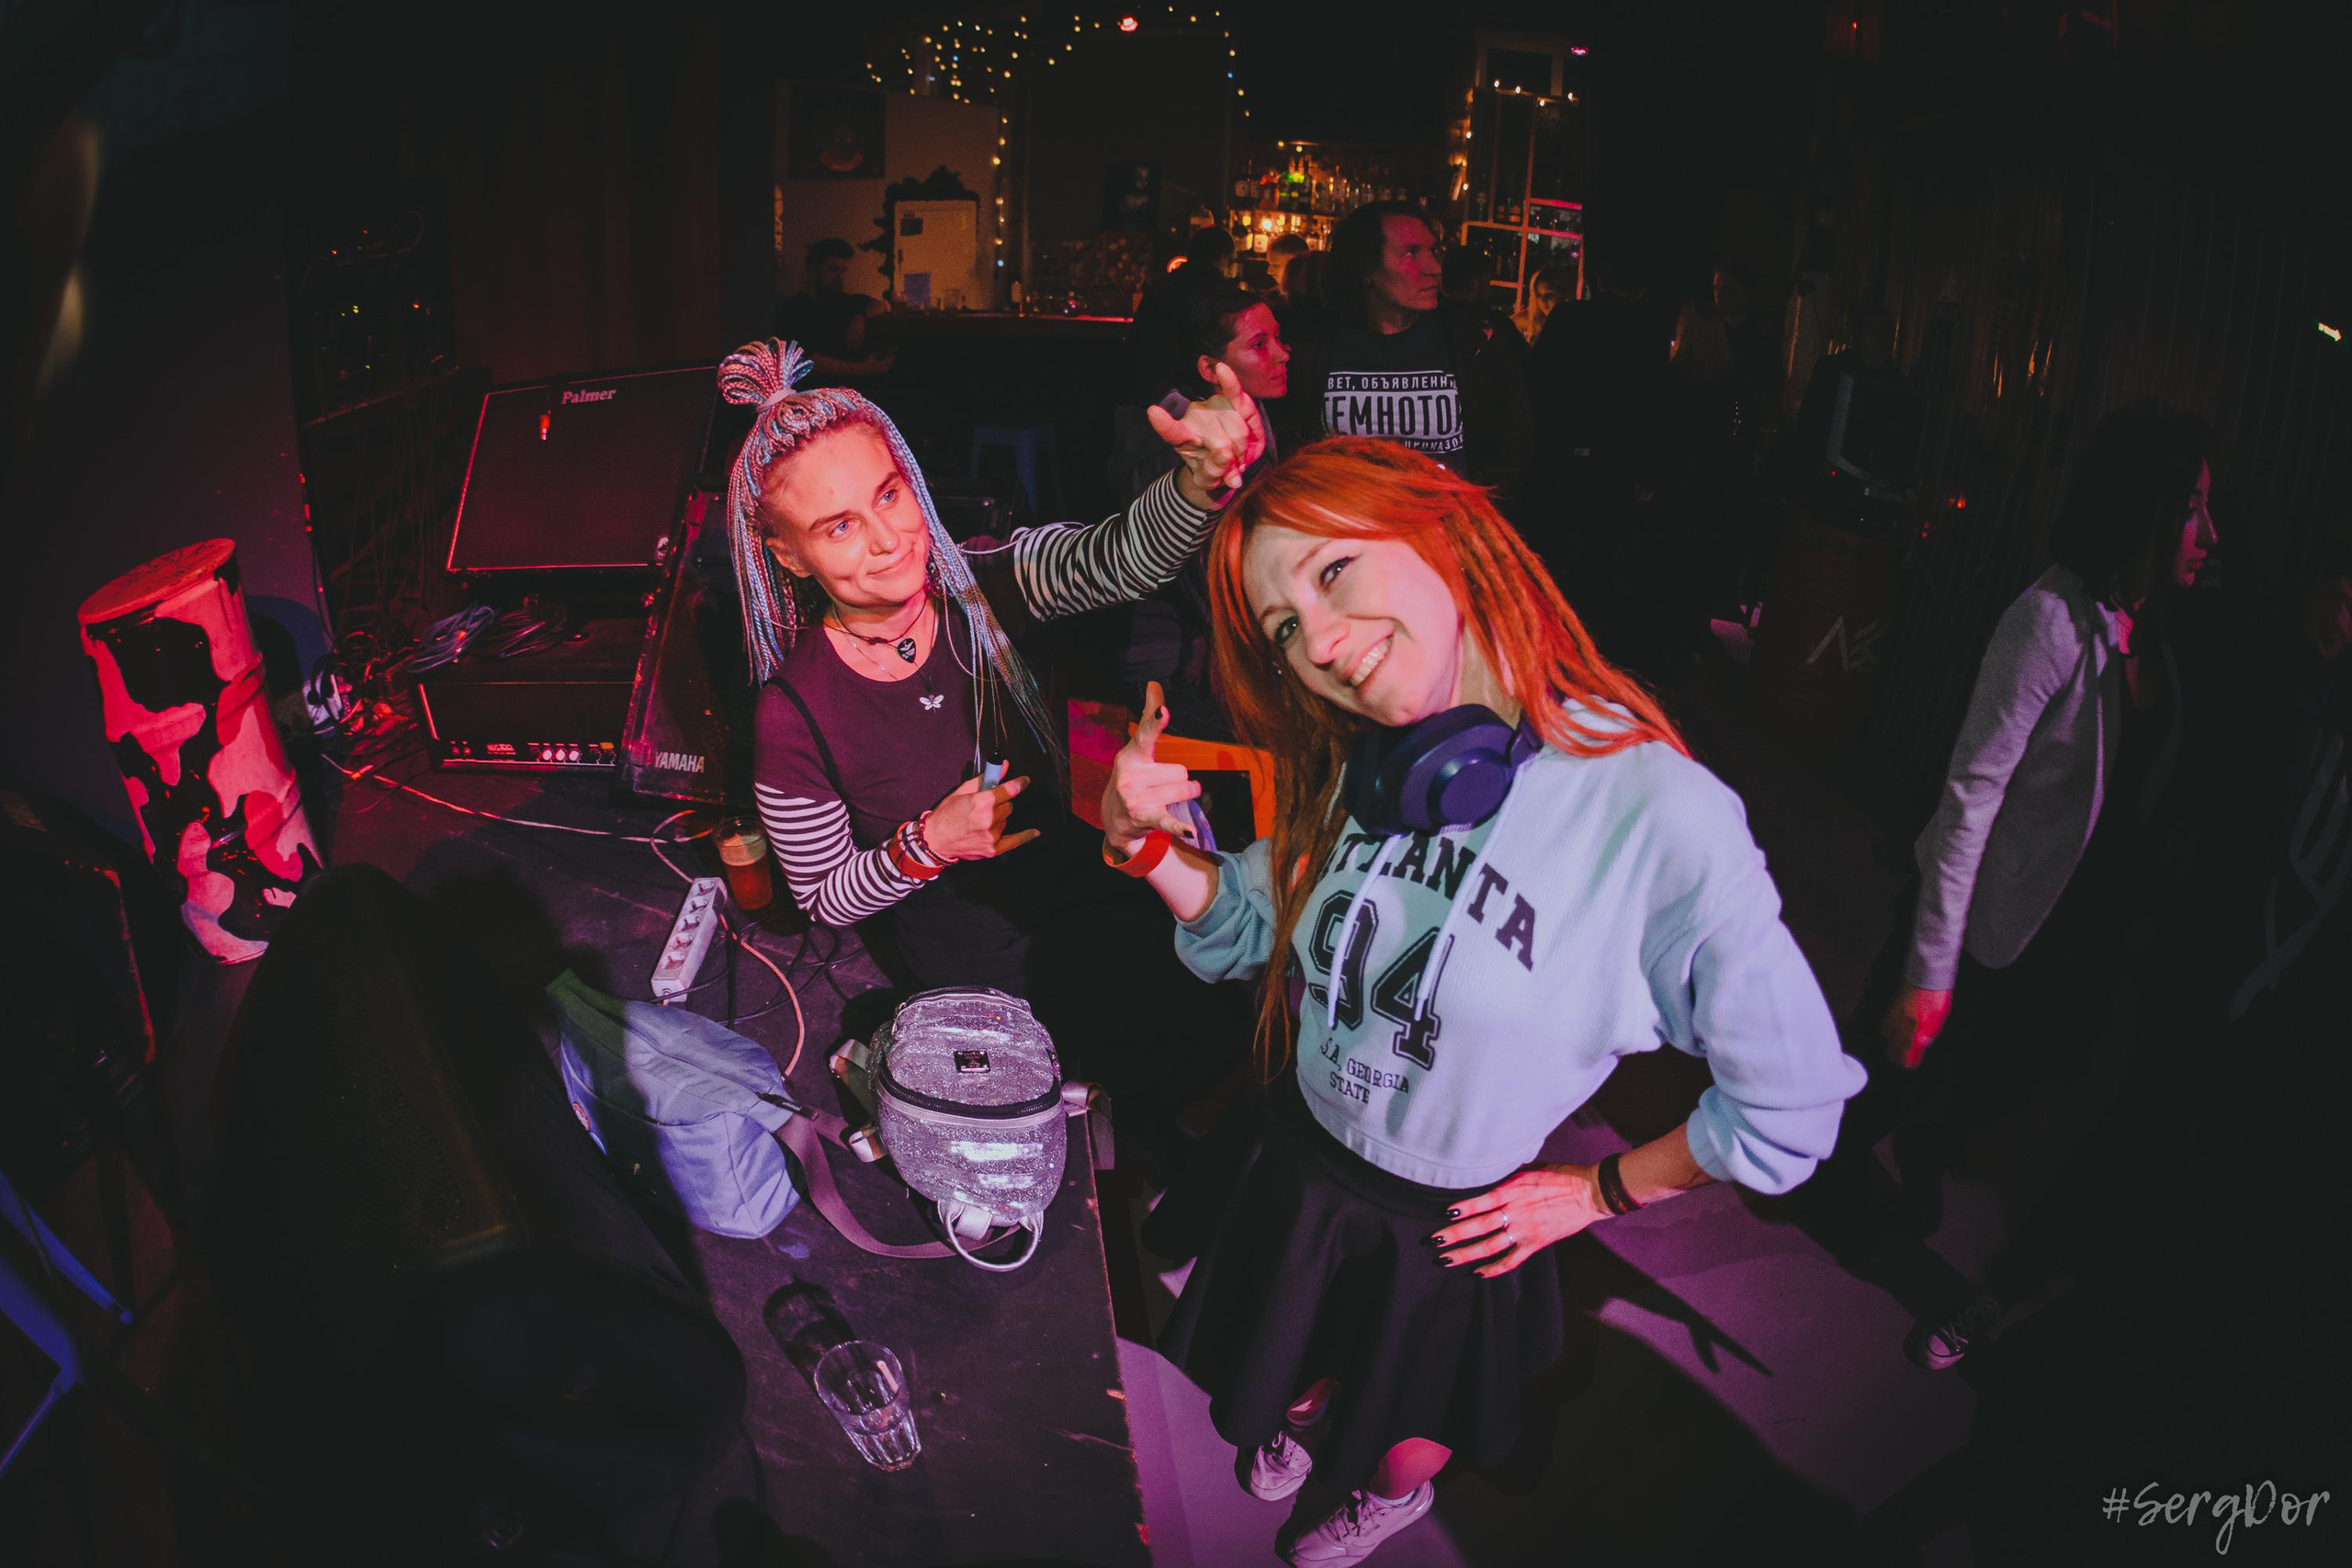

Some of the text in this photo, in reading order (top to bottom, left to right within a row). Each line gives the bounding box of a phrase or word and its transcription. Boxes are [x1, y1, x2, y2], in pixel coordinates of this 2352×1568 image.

[560, 389, 616, 405] Palmer
[654, 751, 705, 773] YAMAHA
[1320, 830, 1535, 973] TLANTA
[1308, 889, 1455, 1071] 94
[1329, 1071, 1371, 1104] STATE
[1347, 1058, 1409, 1093] GEORGIA
